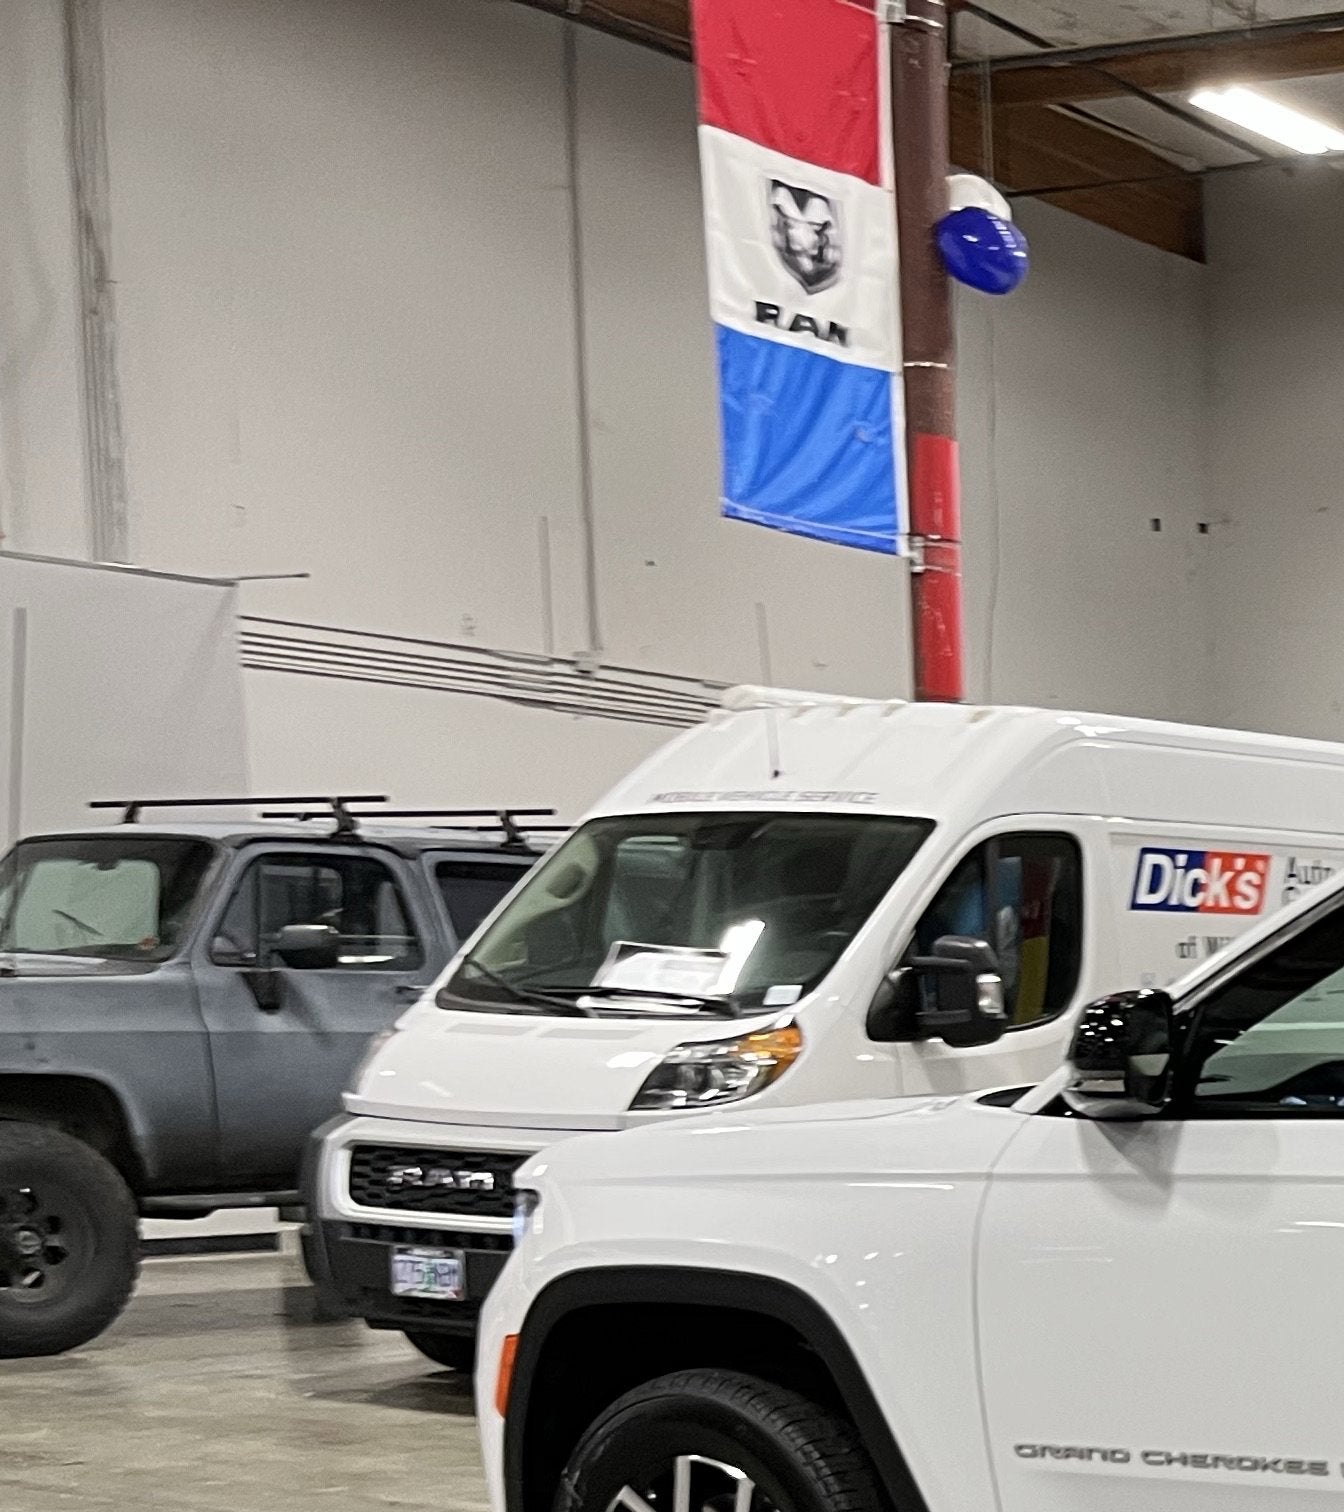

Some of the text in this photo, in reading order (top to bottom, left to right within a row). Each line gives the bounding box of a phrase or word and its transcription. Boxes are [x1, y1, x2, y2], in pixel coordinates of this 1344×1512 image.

[1135, 852, 1261, 910] Dick's
[1013, 1443, 1131, 1464] GRAND
[1140, 1449, 1330, 1477] CHEROKEE
